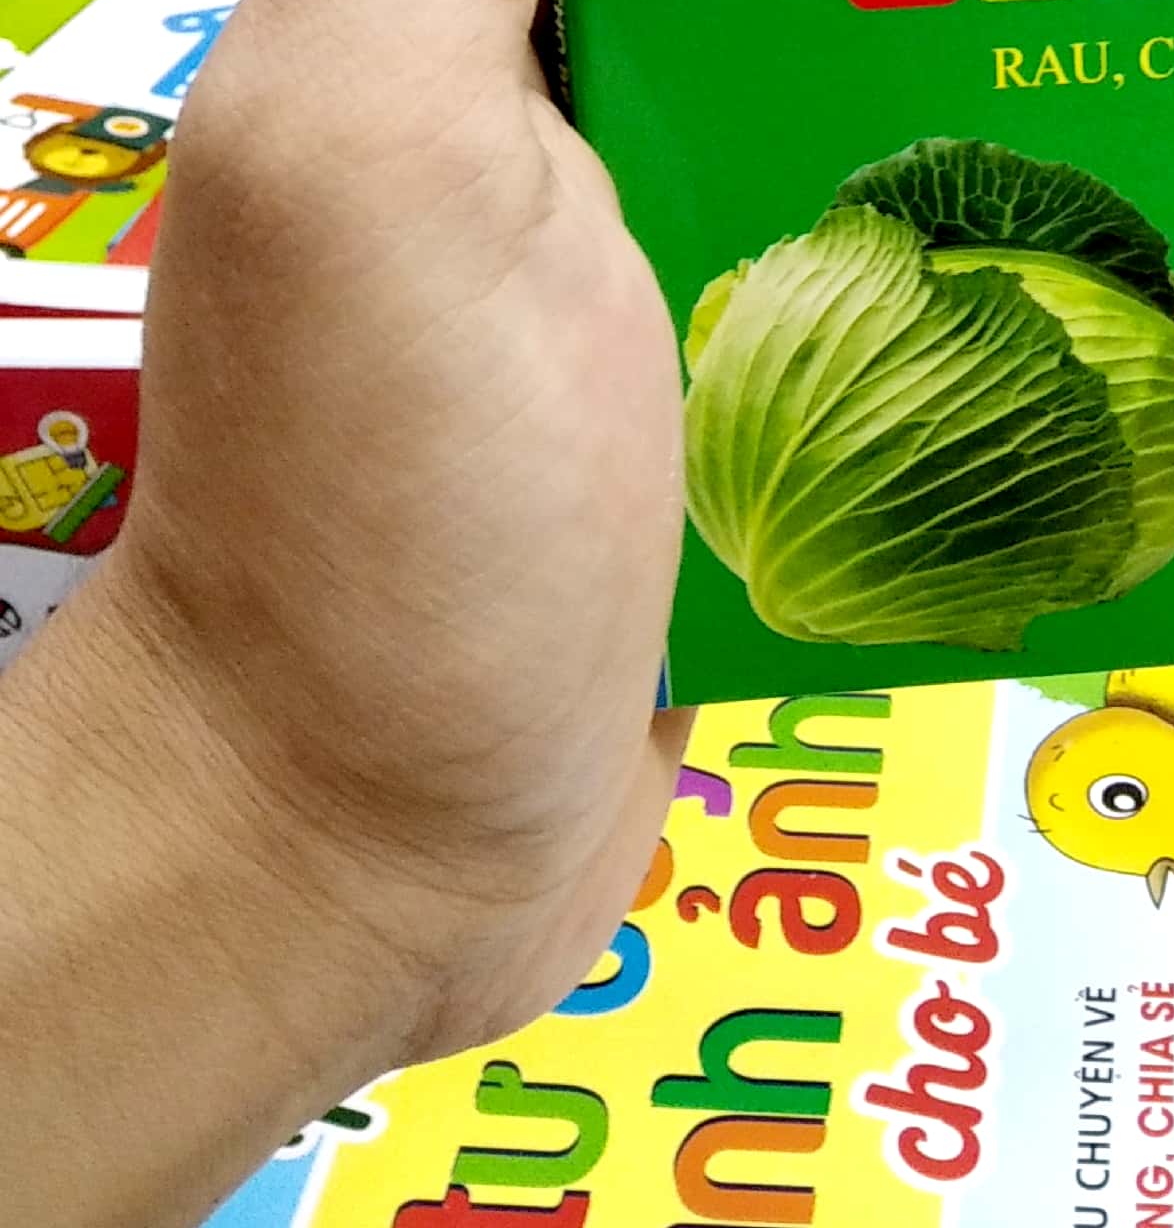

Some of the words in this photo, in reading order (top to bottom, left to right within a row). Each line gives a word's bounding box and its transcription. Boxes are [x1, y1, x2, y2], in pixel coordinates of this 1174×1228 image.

[991, 40, 1126, 91] RAU,
[676, 693, 892, 956] ảnh
[886, 849, 1005, 964] bé
[863, 979, 992, 1182] cho
[1074, 985, 1117, 1028] VỀ
[650, 1007, 844, 1228] nh
[1073, 1039, 1122, 1192] CHUYỆN
